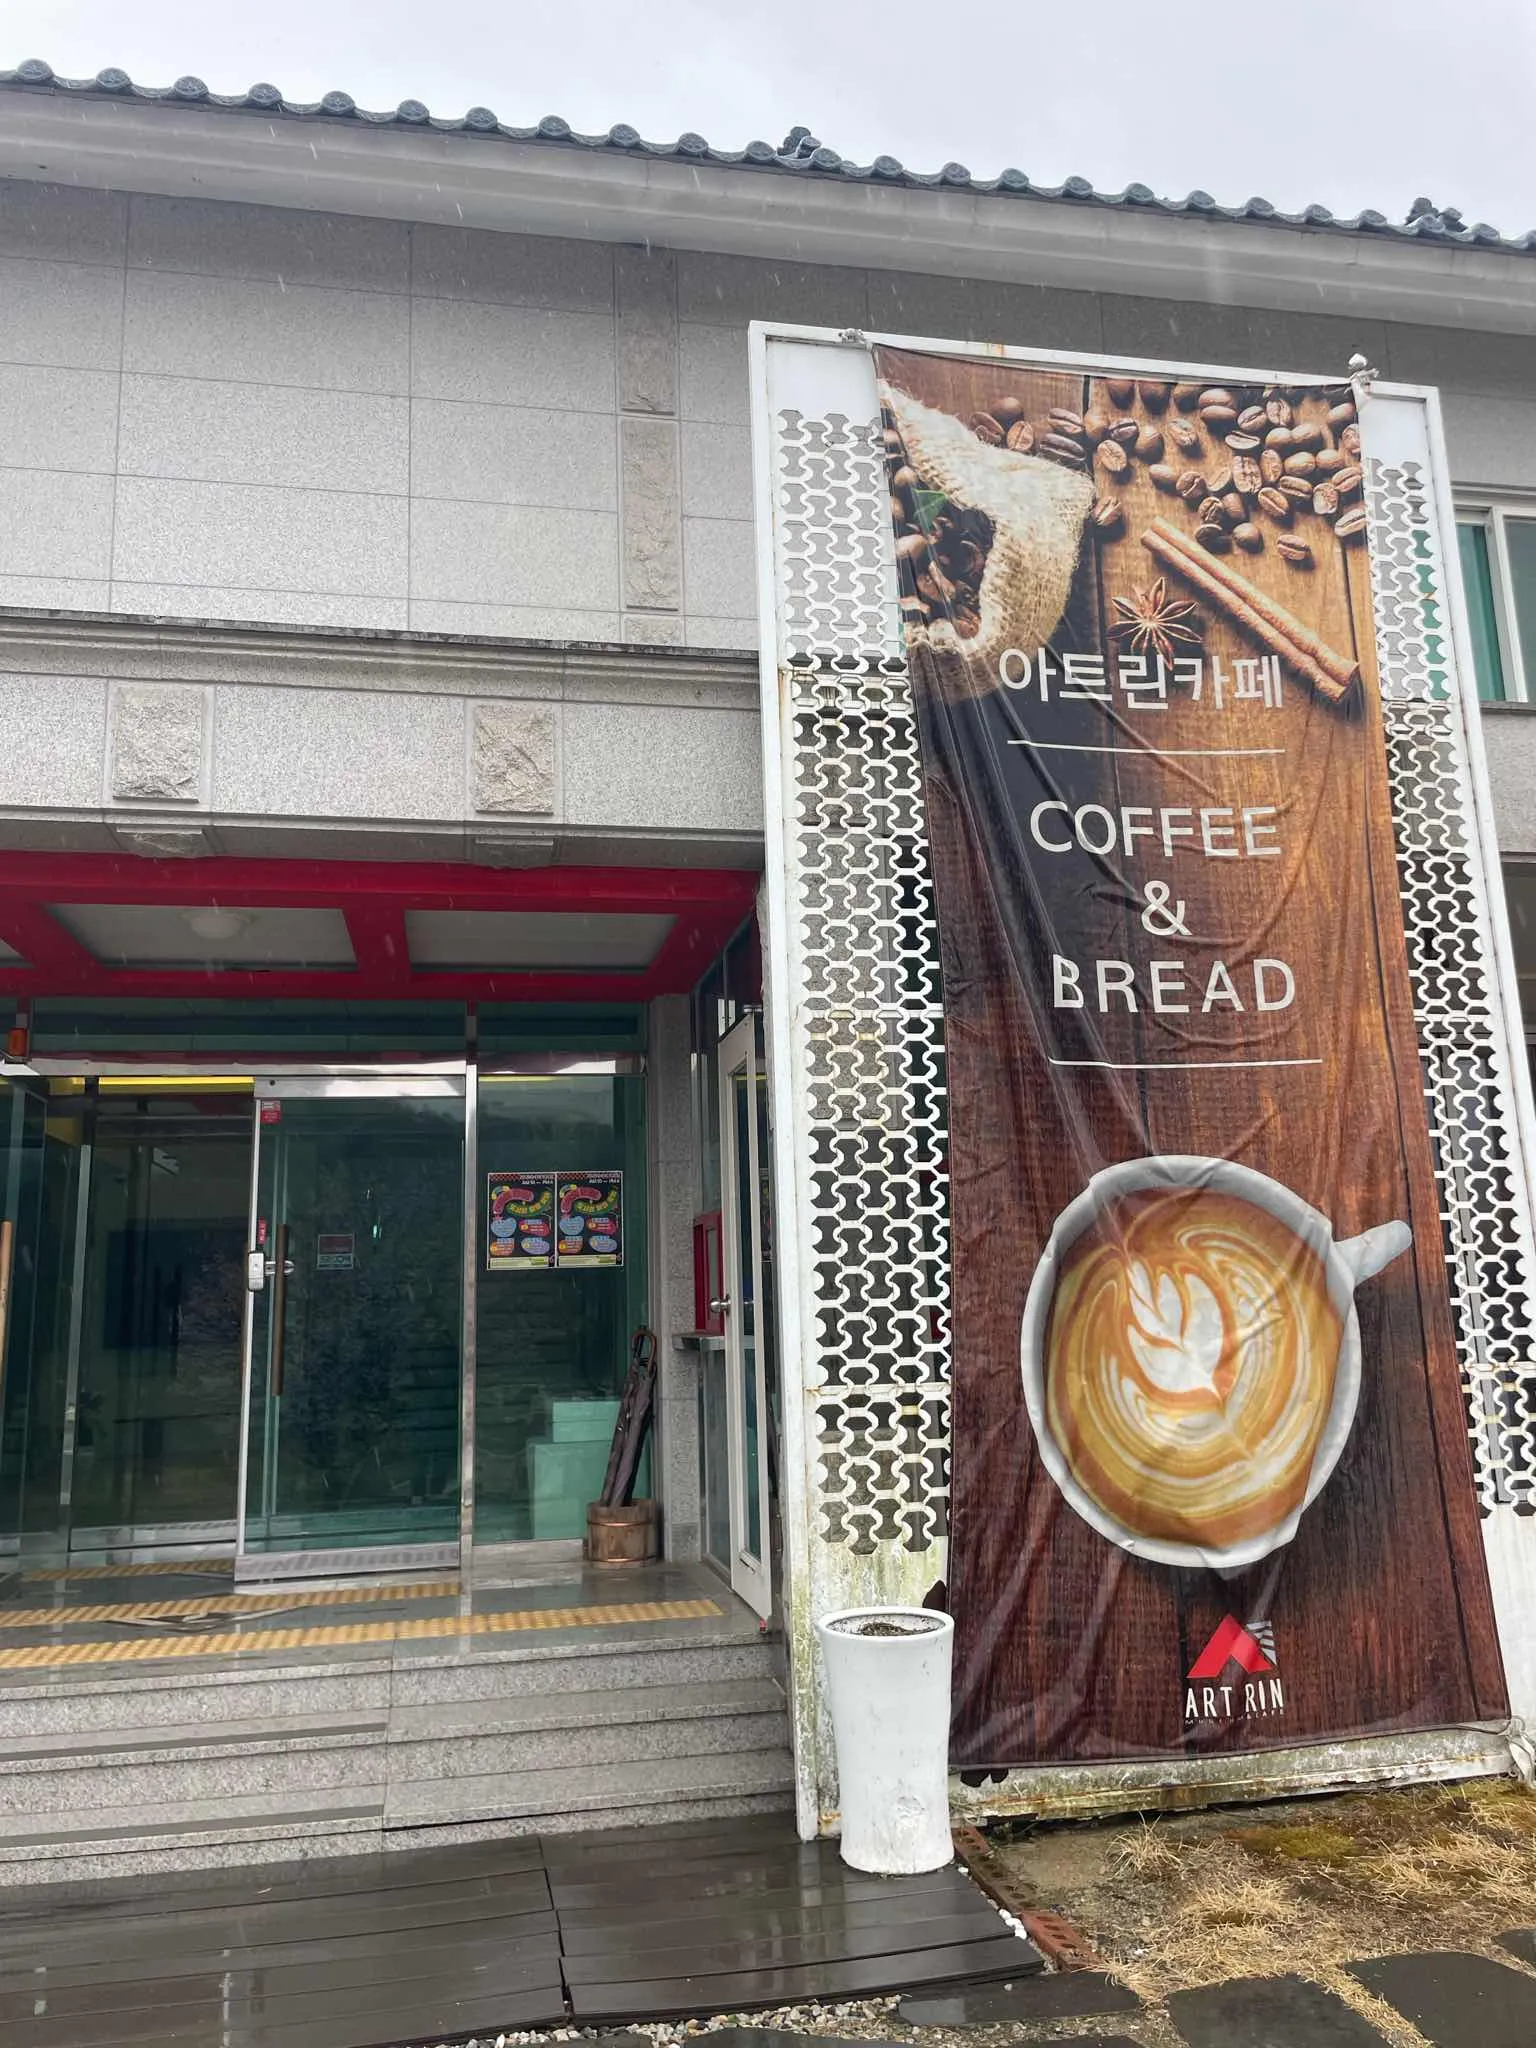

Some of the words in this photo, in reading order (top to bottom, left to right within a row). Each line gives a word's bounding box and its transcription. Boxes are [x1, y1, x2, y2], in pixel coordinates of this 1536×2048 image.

[999, 647, 1283, 710] 아트린카페
[1029, 800, 1282, 857] COFFEE
[1140, 880, 1192, 936] &
[1052, 953, 1296, 1014] BREAD
[1185, 1686, 1233, 1718] ART
[1244, 1678, 1284, 1713] RIN
